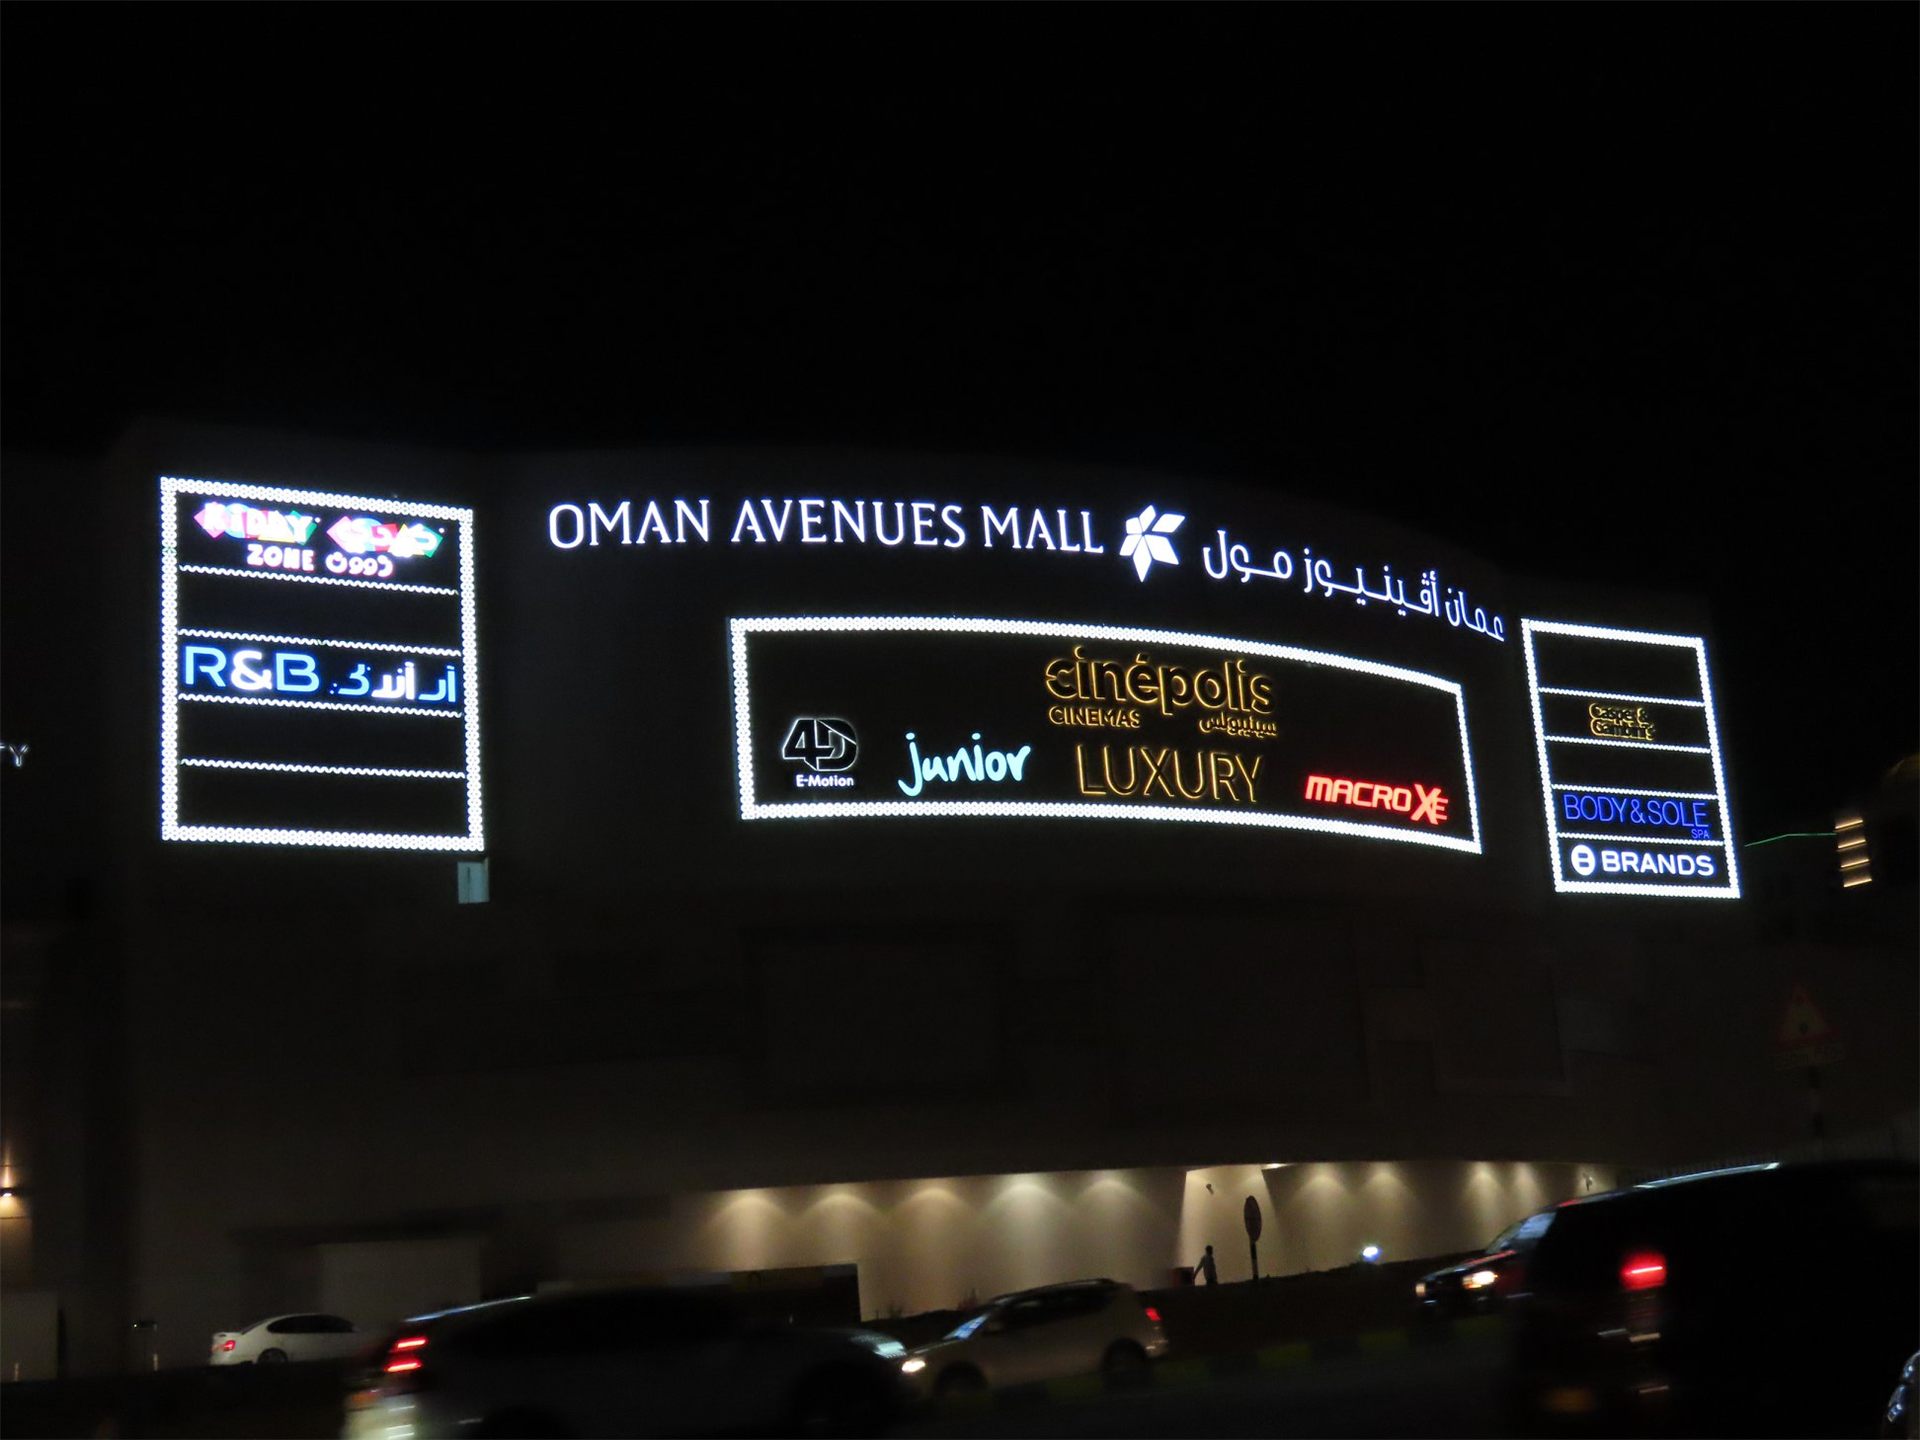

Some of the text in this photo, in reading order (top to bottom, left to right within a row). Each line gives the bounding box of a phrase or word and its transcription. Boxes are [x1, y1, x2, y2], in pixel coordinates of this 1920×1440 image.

[548, 500, 1104, 554] OMAN AVENUES MALL
[247, 544, 314, 571] ZONE
[1203, 530, 1293, 582] مول
[1445, 588, 1505, 642] عمان
[185, 646, 320, 692] R&B
[1049, 706, 1141, 729] CINEMAS
[782, 717, 859, 772] 4D
[898, 732, 1031, 797] junior
[796, 775, 855, 788] E-Motion
[1077, 744, 1264, 802] LUXURY
[1691, 828, 1711, 839] SPA
[1601, 850, 1714, 876] BRANDS
